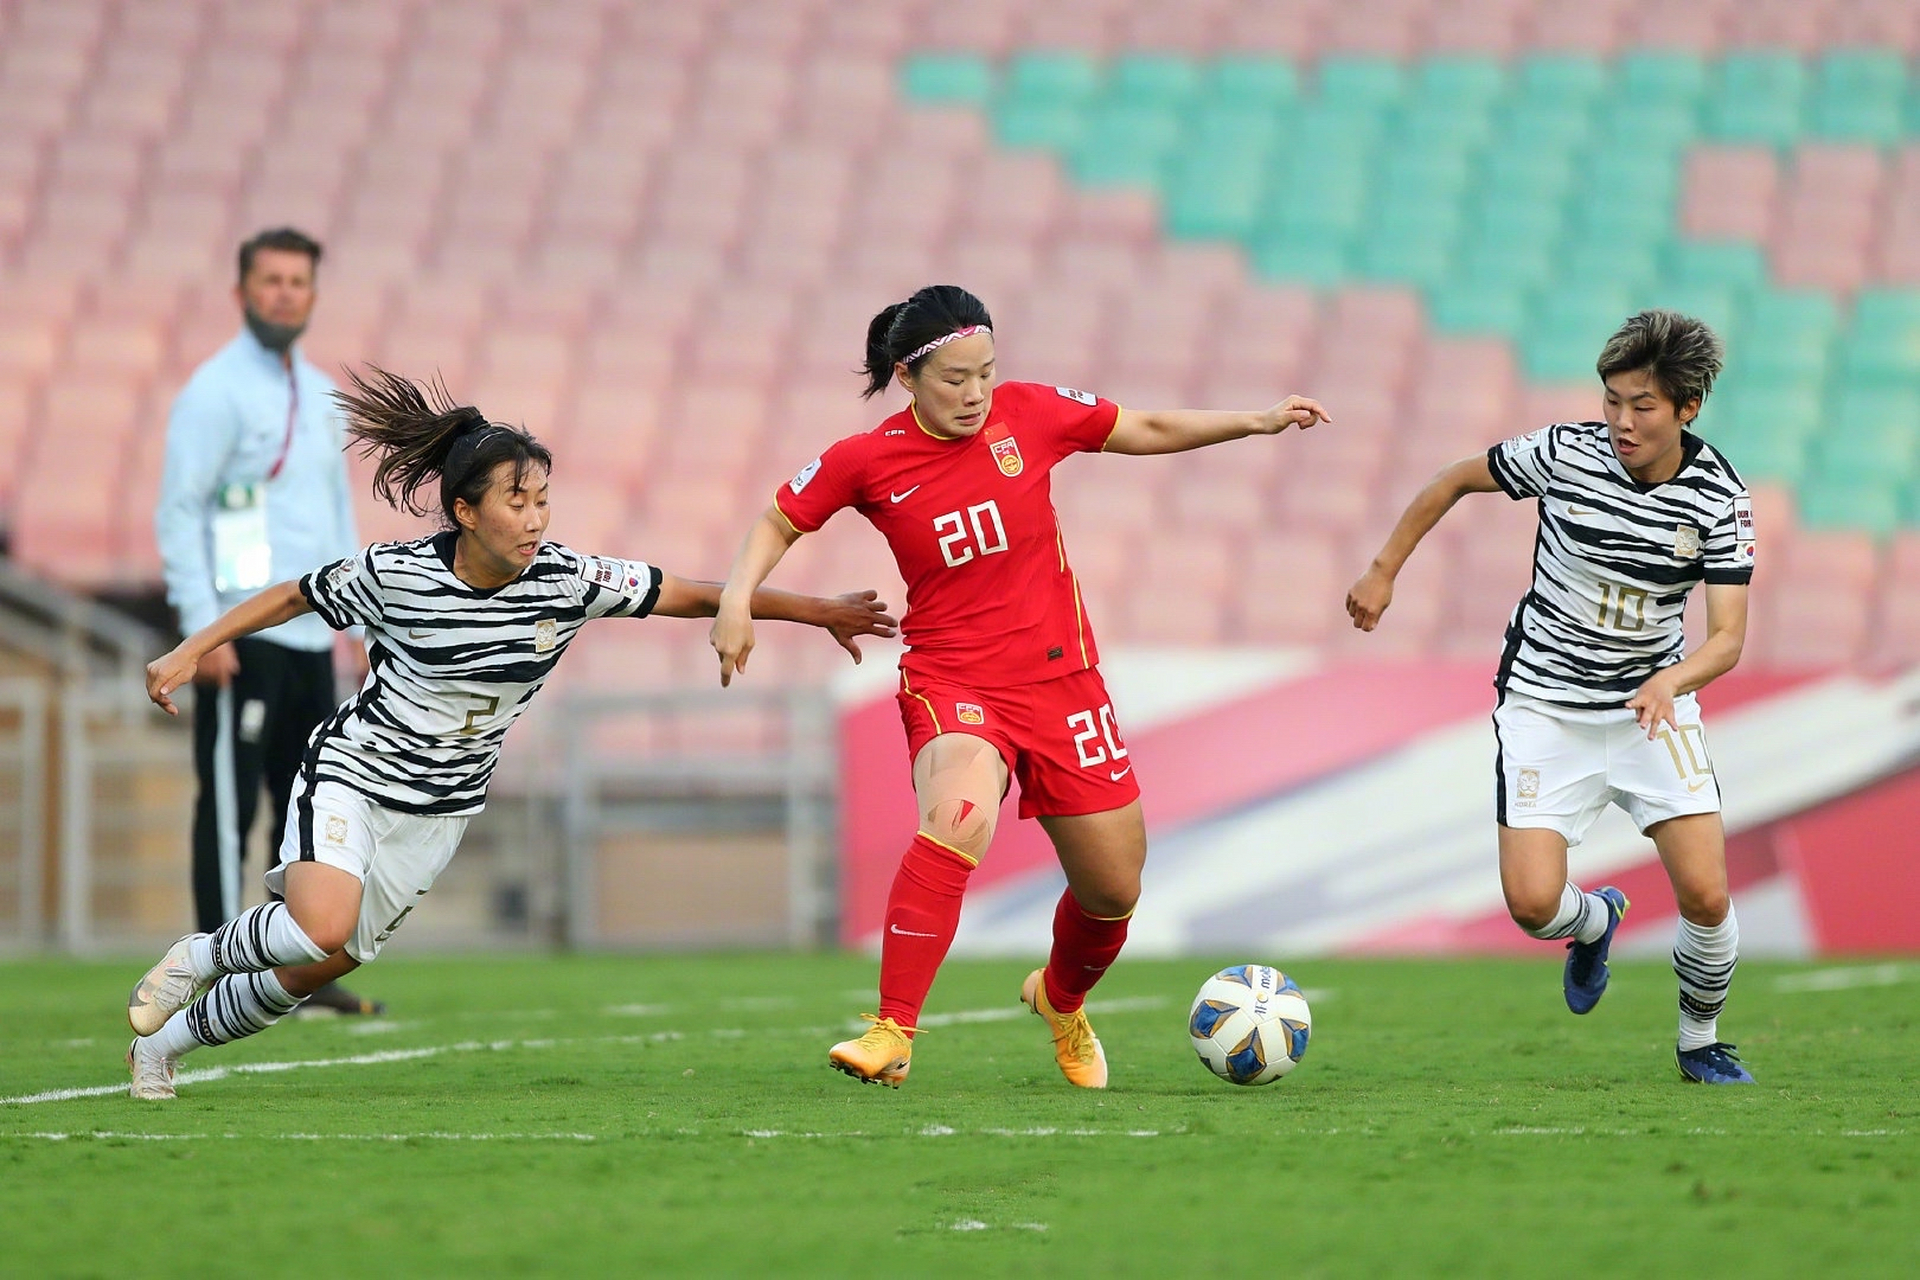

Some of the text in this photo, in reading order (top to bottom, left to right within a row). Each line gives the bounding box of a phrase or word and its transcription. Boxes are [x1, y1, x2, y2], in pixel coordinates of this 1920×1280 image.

[933, 499, 1009, 568] 20
[1597, 581, 1648, 632] 10
[459, 692, 500, 736] 2
[1066, 703, 1128, 769] 20
[1656, 723, 1712, 780] 10
